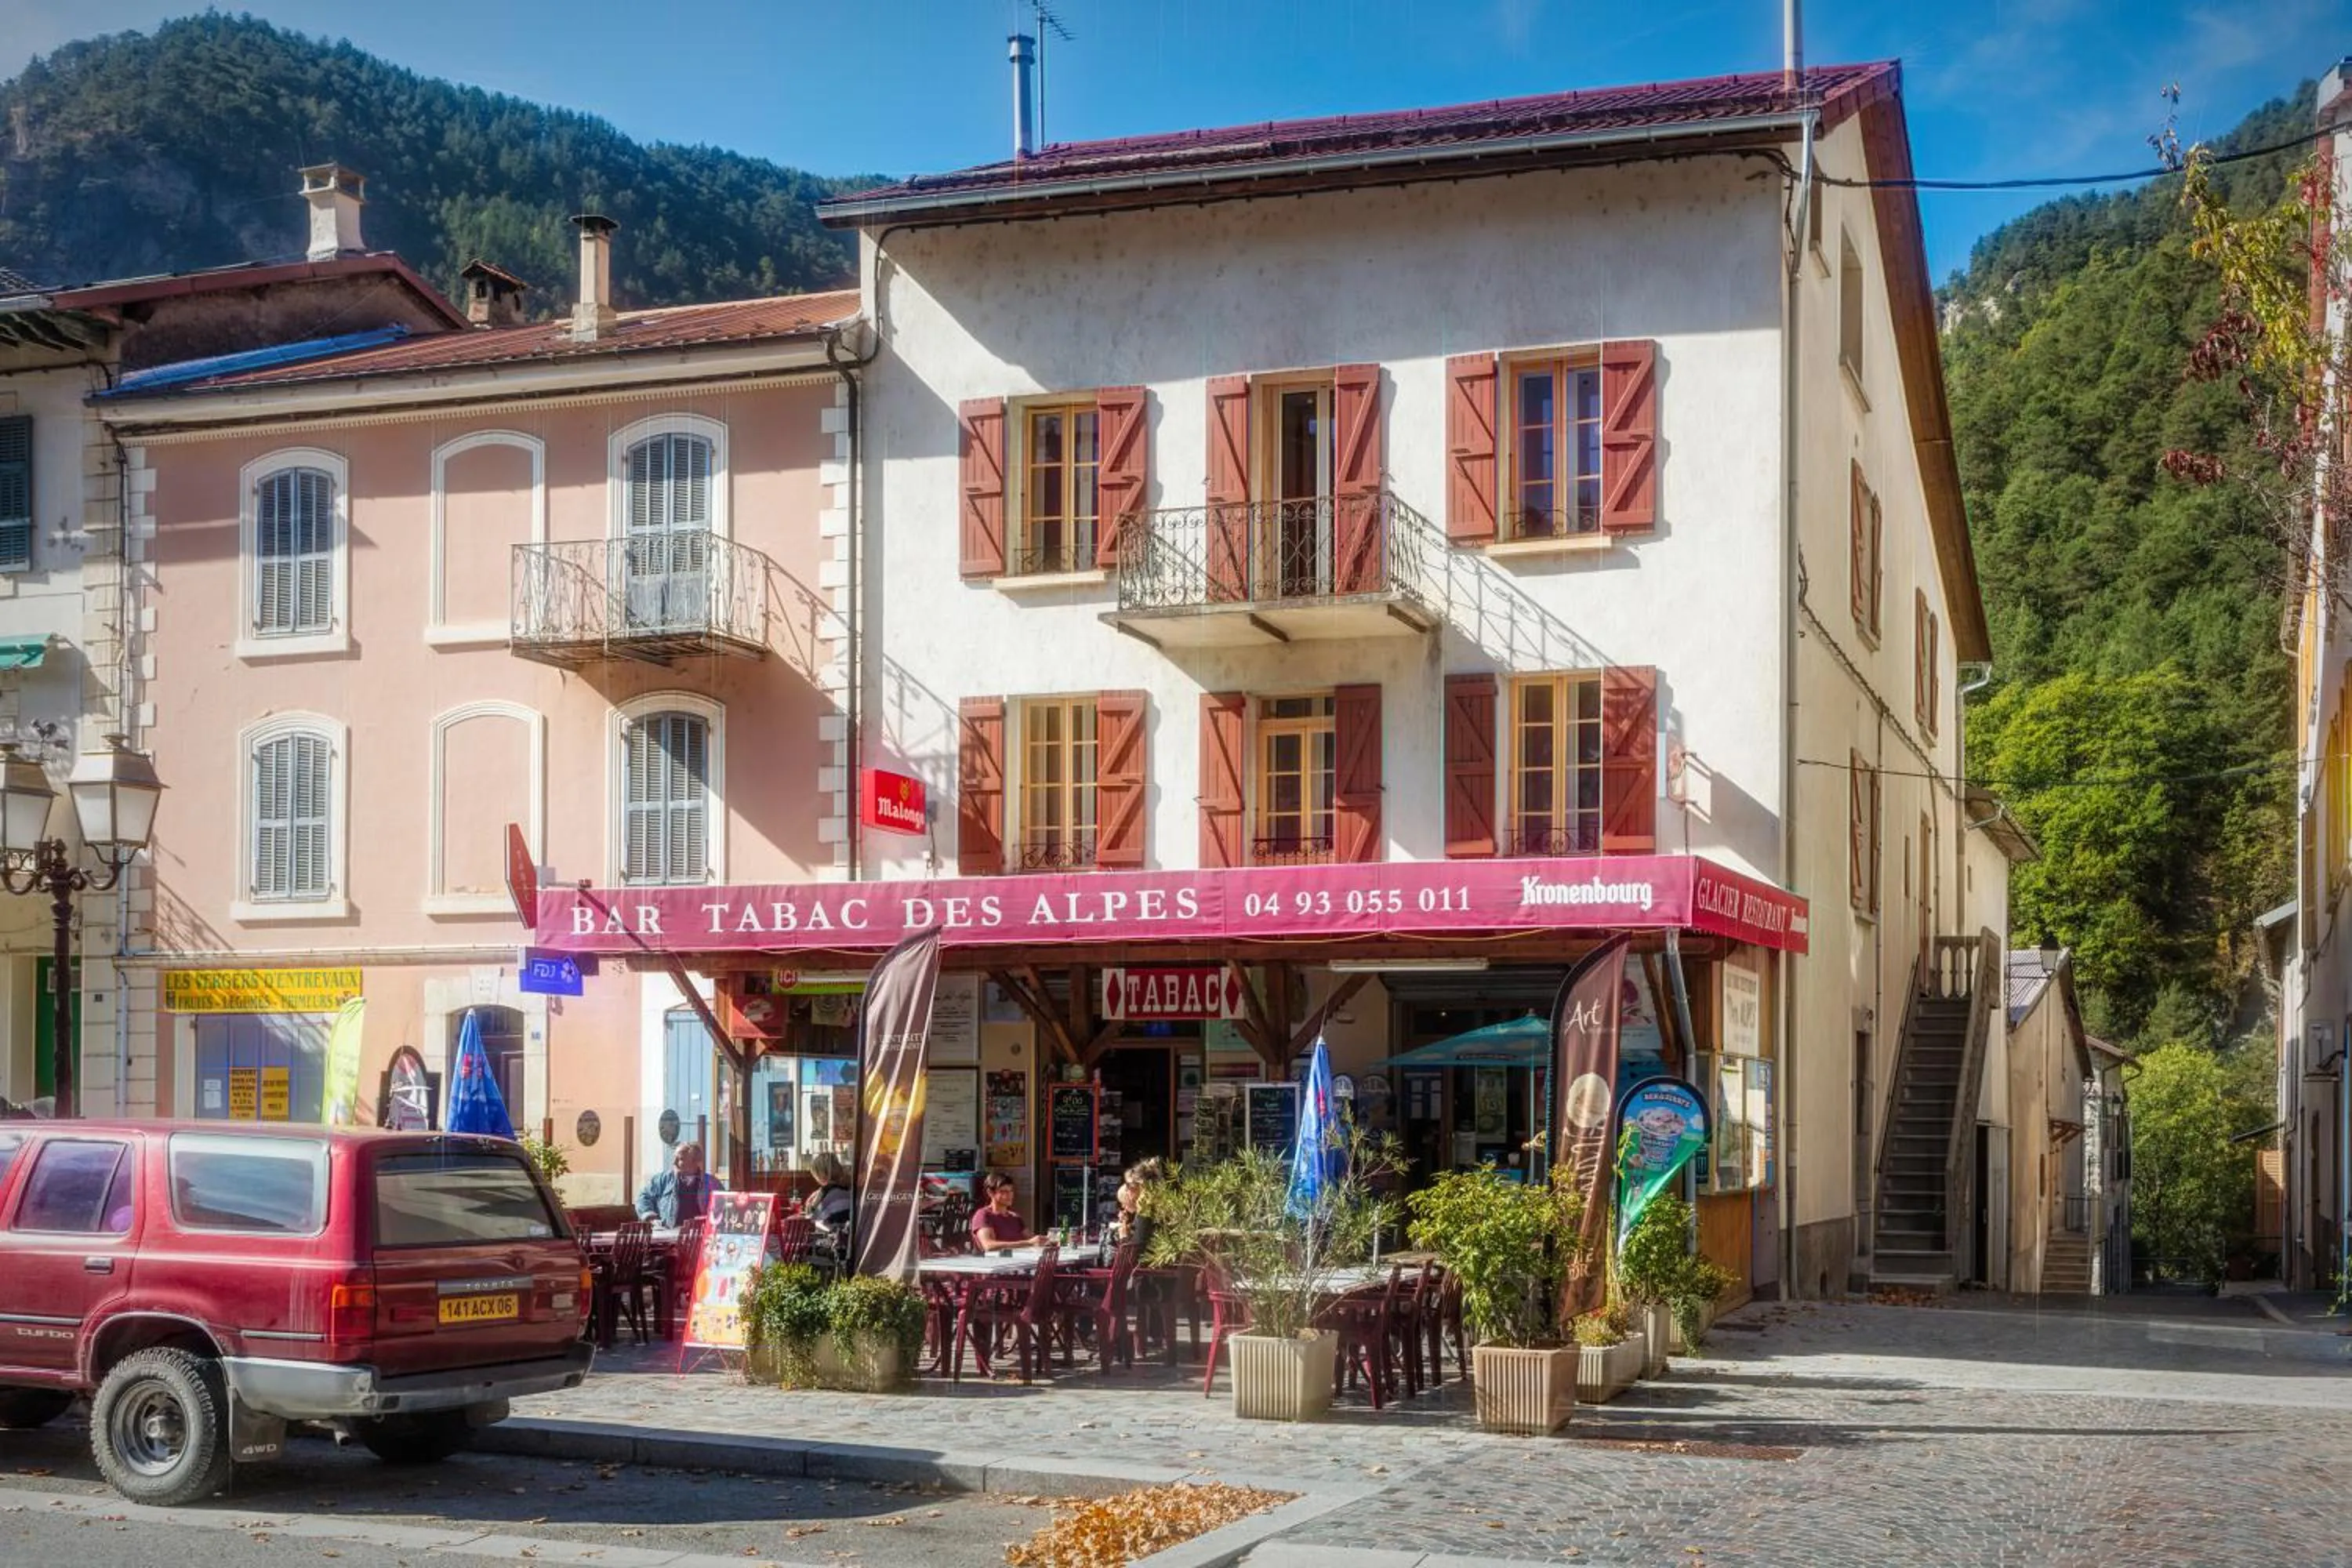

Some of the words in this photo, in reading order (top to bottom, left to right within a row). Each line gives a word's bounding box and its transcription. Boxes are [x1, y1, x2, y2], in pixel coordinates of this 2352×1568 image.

[1244, 892, 1280, 916] 04
[1296, 891, 1330, 915] 93
[1347, 888, 1403, 913] 055
[1418, 886, 1472, 912] 011
[1520, 876, 1652, 911] Kronenbourg
[1697, 877, 1740, 920] GLACIER
[571, 906, 663, 935] BAR
[702, 899, 868, 933] TABAC
[902, 895, 1002, 929] DES
[1028, 887, 1199, 924] ALPES
[165, 972, 191, 989] LES
[195, 971, 260, 989] VERGERS
[533, 964, 556, 978] FDJ
[1127, 974, 1219, 1012] TABAC
[1564, 998, 1602, 1035] Art
[447, 1301, 469, 1317] 141
[471, 1299, 495, 1316] ACX
[497, 1298, 512, 1312] 06
[241, 1443, 277, 1455] 4WD
